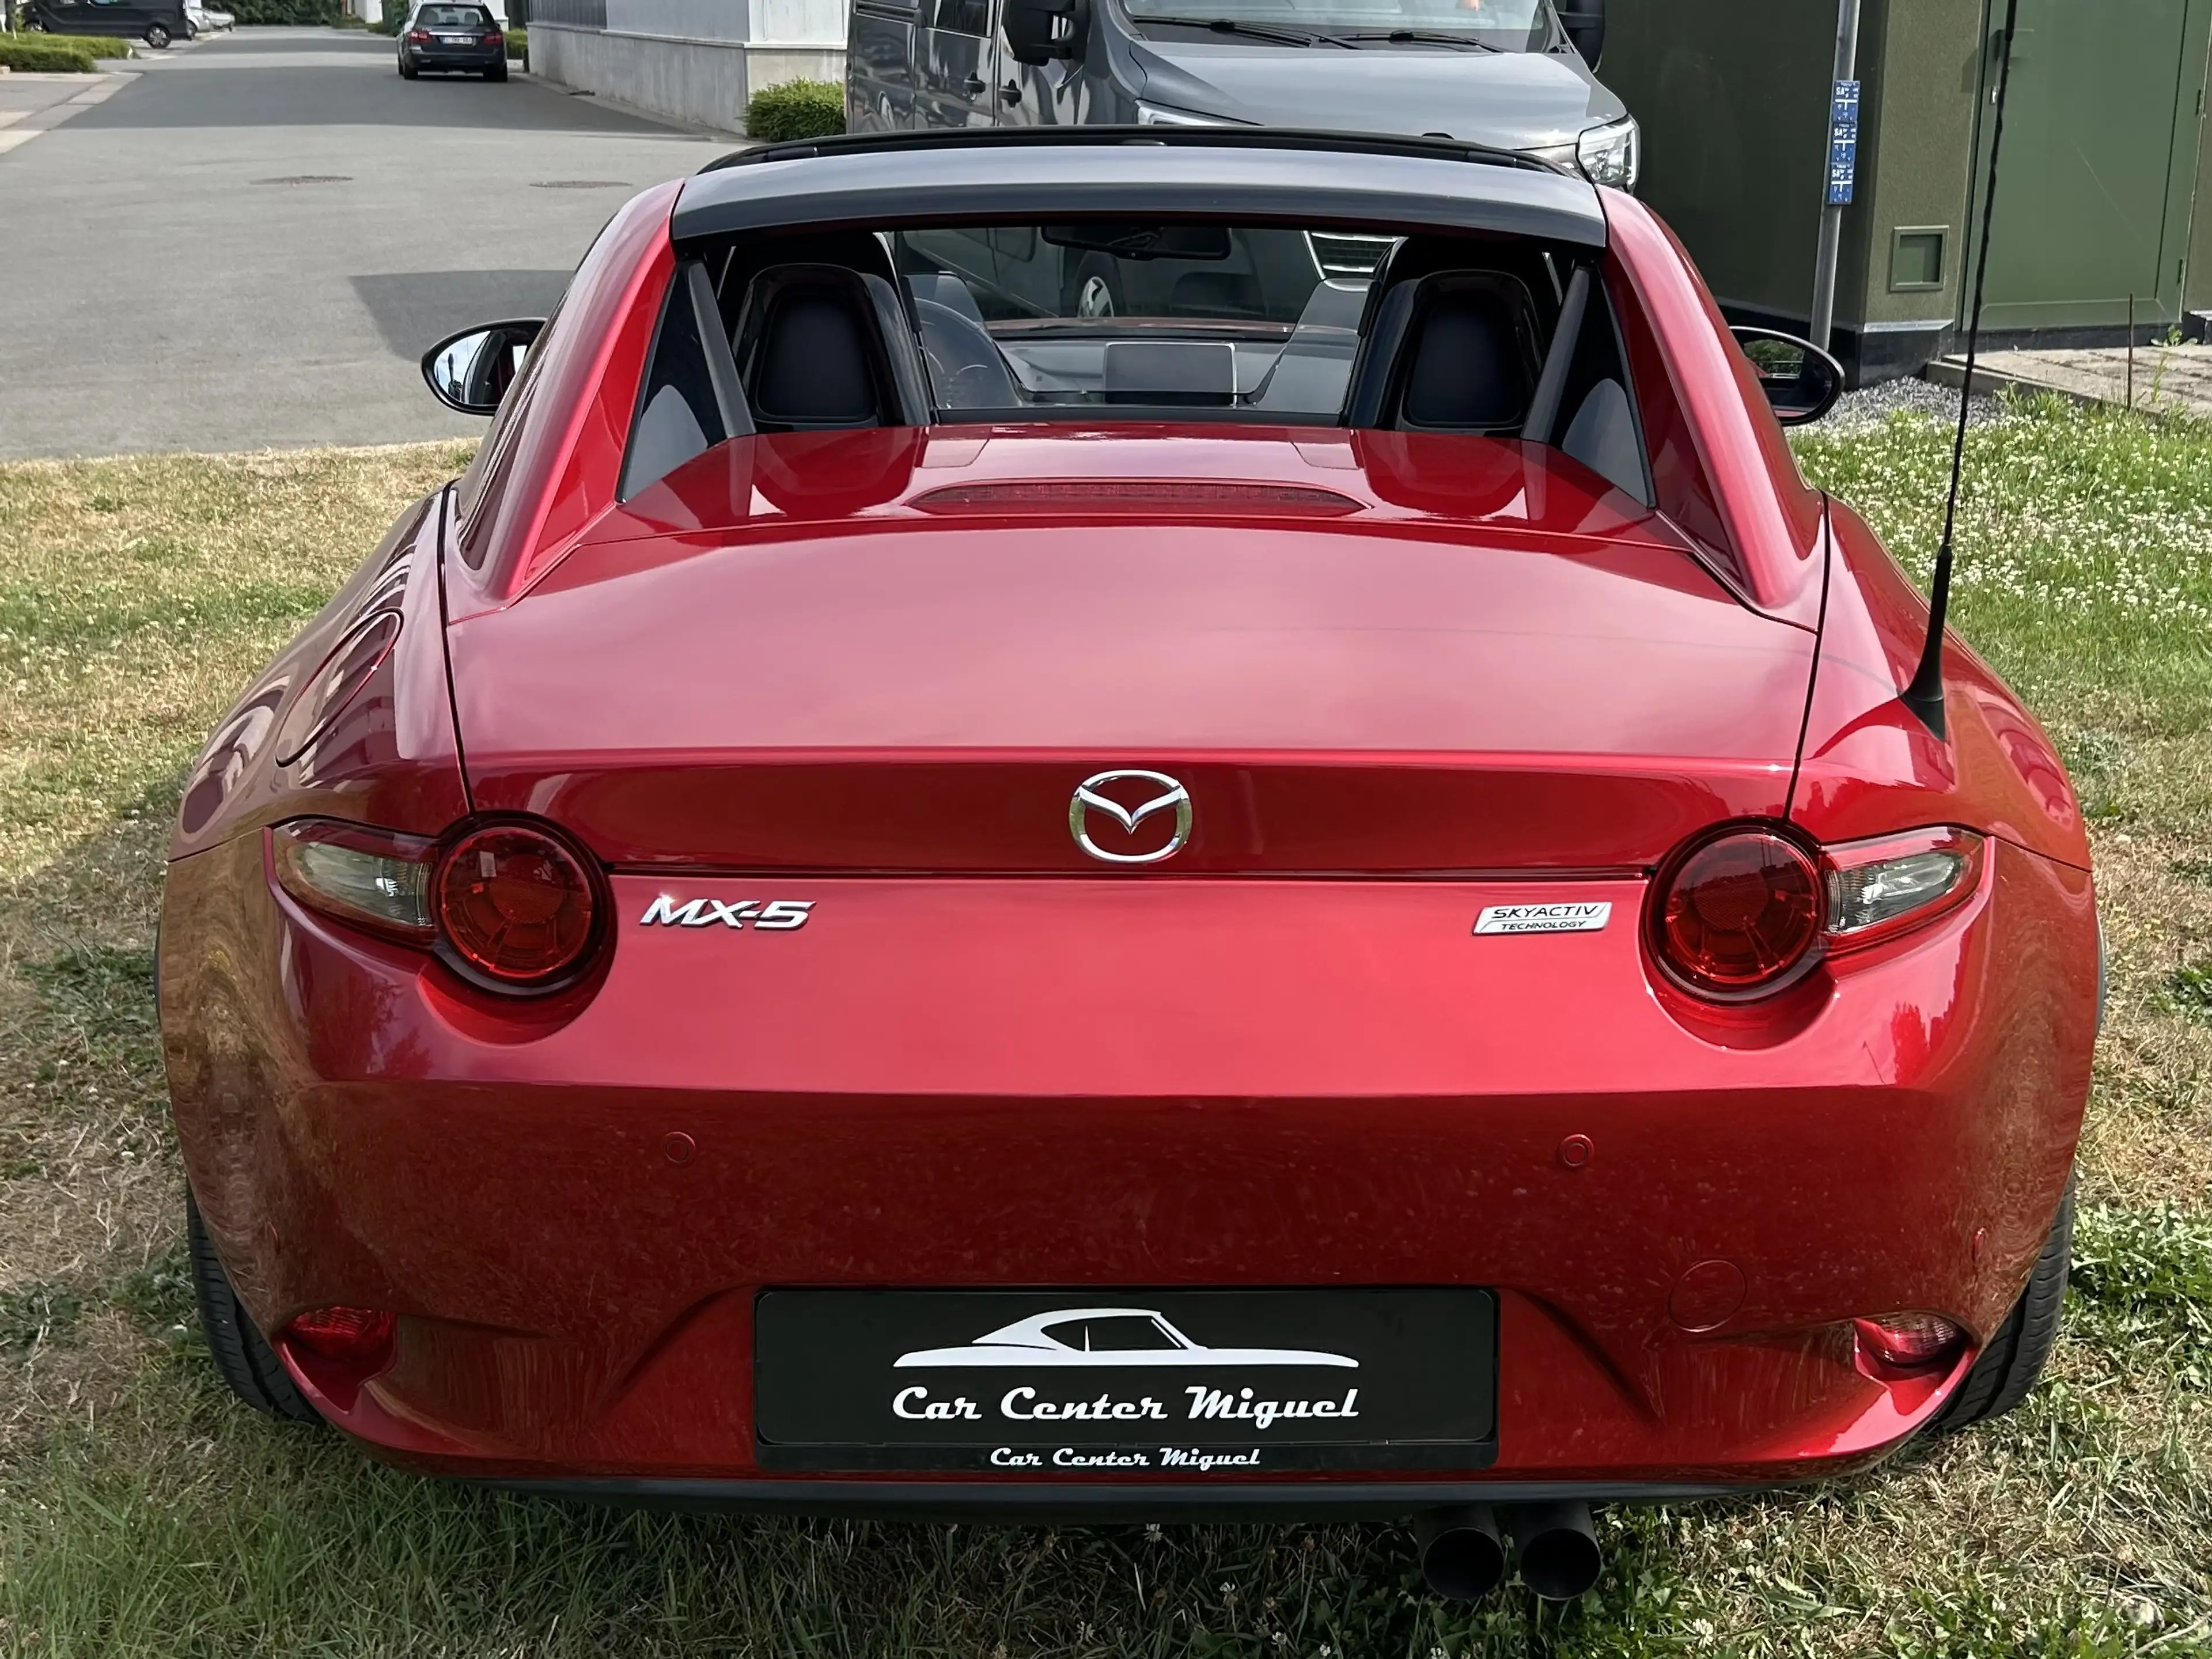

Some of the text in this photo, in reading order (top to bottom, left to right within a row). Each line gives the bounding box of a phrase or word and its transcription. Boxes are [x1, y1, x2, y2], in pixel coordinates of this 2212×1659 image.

[639, 895, 816, 930] MX-5
[1491, 905, 1599, 919] SKYACTIV
[1501, 921, 1587, 930] TECHNOLOGY
[892, 1386, 1359, 1429] Car Center Miguel
[990, 1447, 1260, 1471] Car Center Miguel
